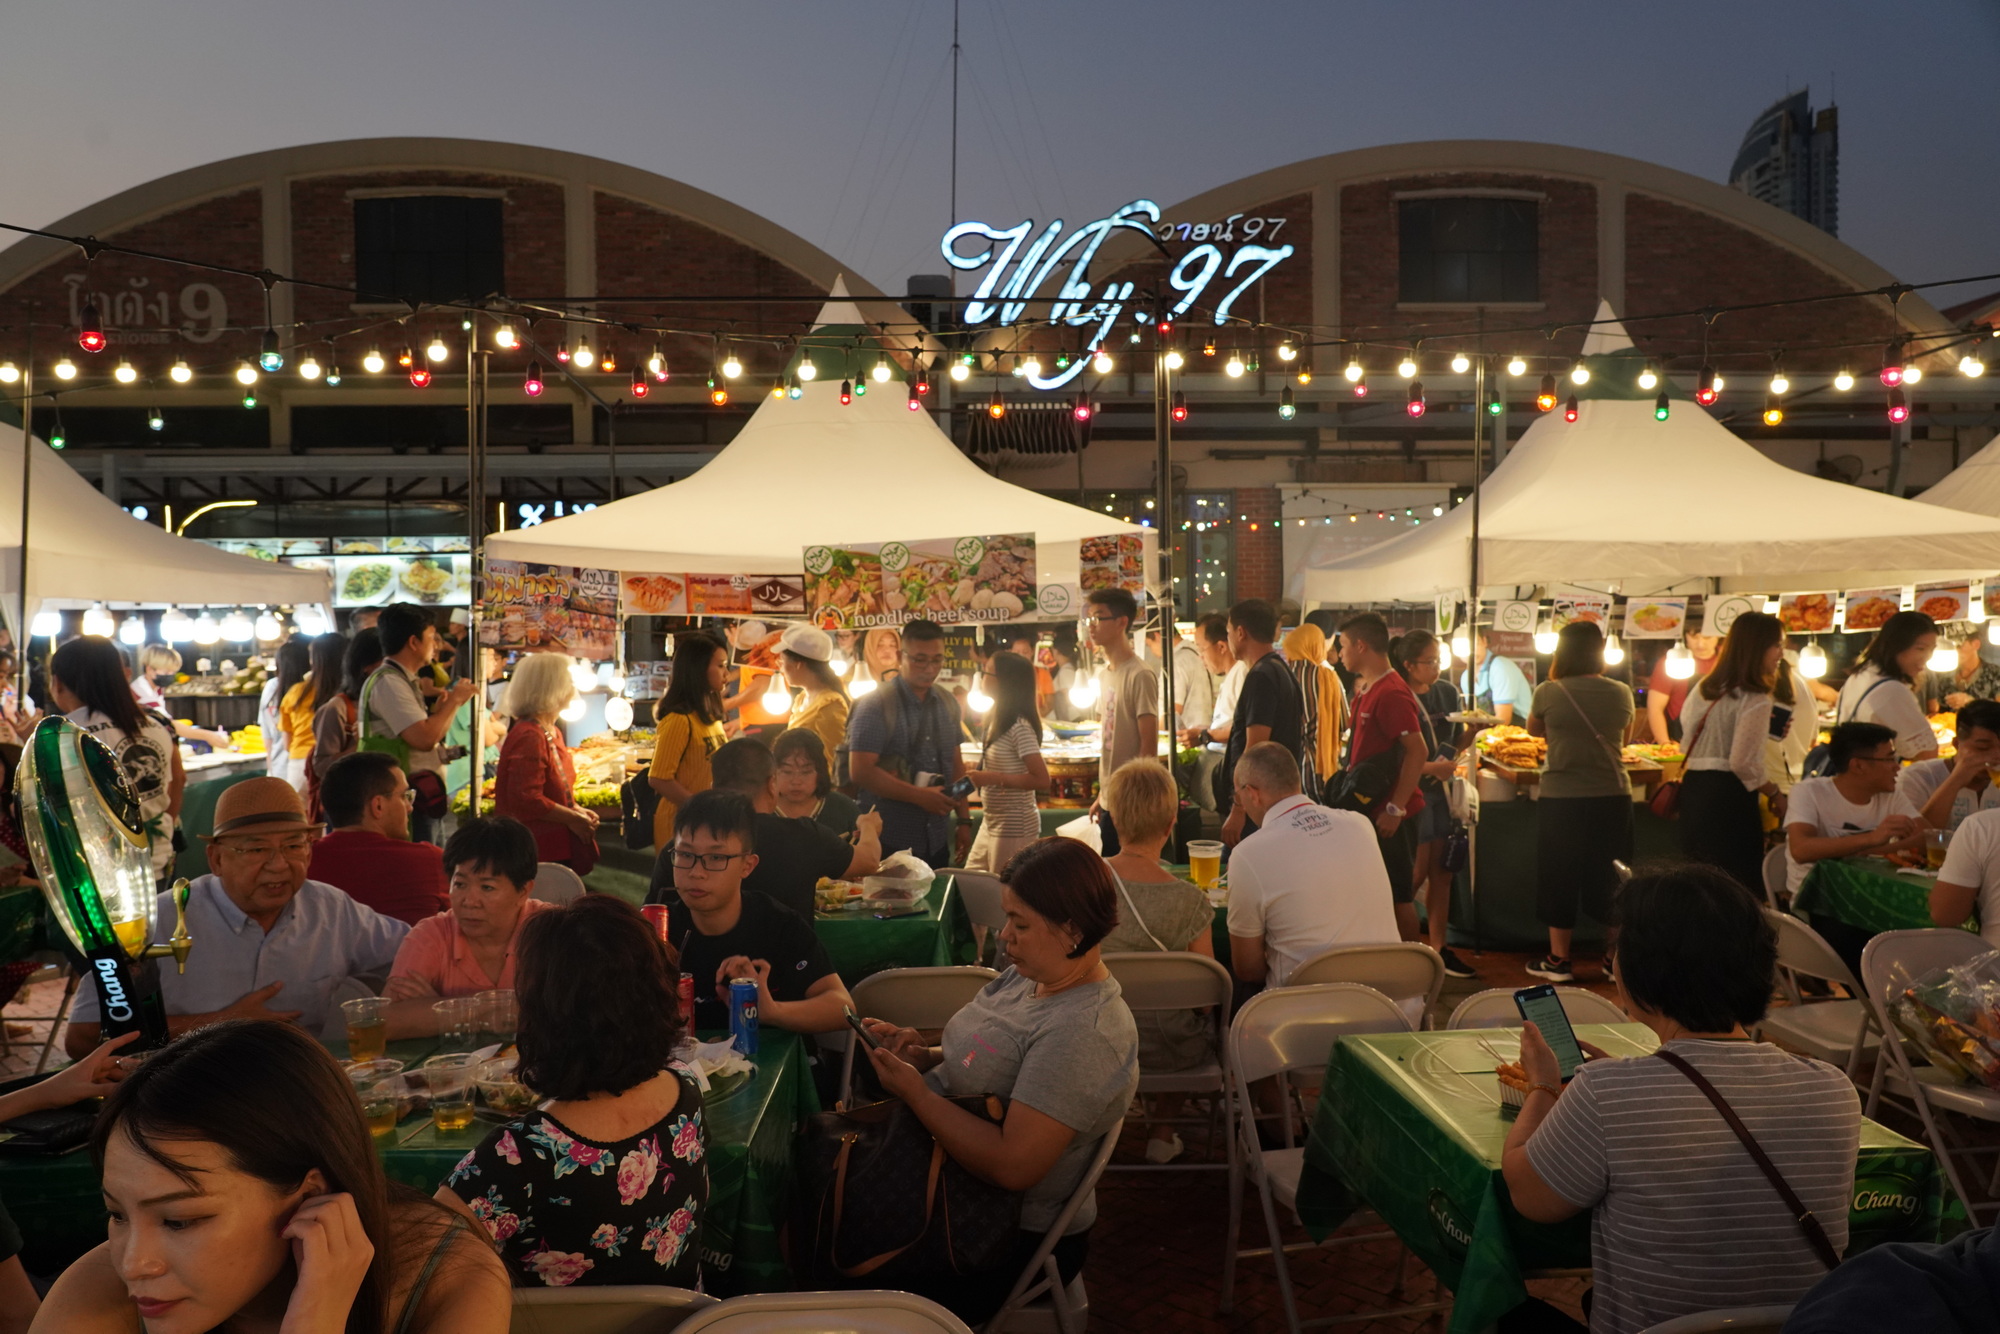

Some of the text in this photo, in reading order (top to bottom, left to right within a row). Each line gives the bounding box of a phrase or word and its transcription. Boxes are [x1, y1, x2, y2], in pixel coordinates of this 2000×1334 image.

[1243, 217, 1287, 242] 97
[179, 282, 229, 344] 9
[854, 606, 1011, 627] noodles beef soup
[94, 957, 134, 1022] Chang
[1853, 1190, 1919, 1215] Chang
[1441, 1210, 1473, 1246] Chan
[700, 1245, 734, 1272] ang
